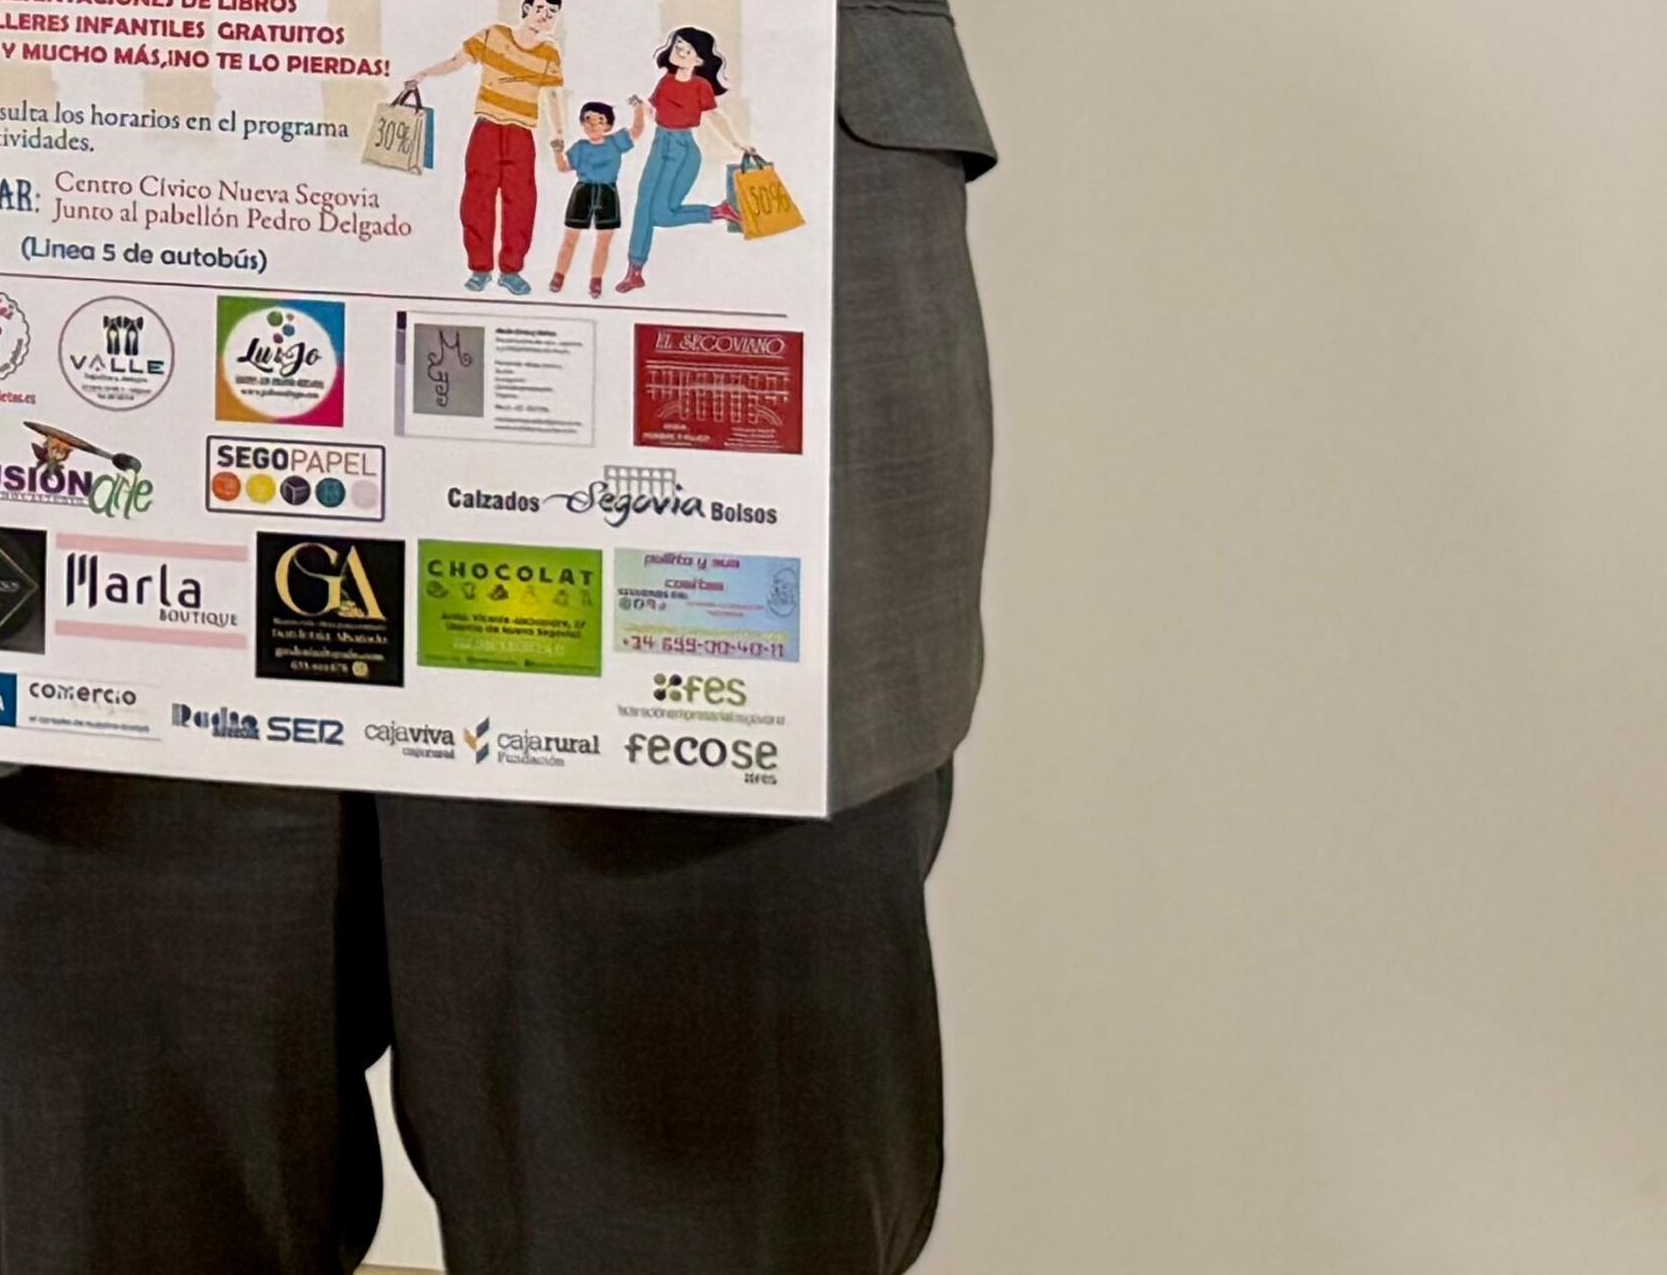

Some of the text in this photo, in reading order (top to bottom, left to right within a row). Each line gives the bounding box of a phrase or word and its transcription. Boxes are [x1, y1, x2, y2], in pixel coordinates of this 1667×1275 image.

[1, 42, 16, 59] Y
[22, 42, 107, 63] MUCHO
[215, 51, 243, 70] TE
[248, 53, 280, 72] LO
[286, 54, 390, 77] PIERDAS!
[53, 100, 85, 125] los
[90, 103, 180, 129] horarios
[185, 116, 212, 131] en
[217, 109, 236, 132] el
[242, 118, 349, 143] programa
[426, 557, 594, 588] CHOCOLAT
[28, 682, 137, 706] comercio
[266, 716, 344, 746] SER
[624, 732, 778, 771] fecose
